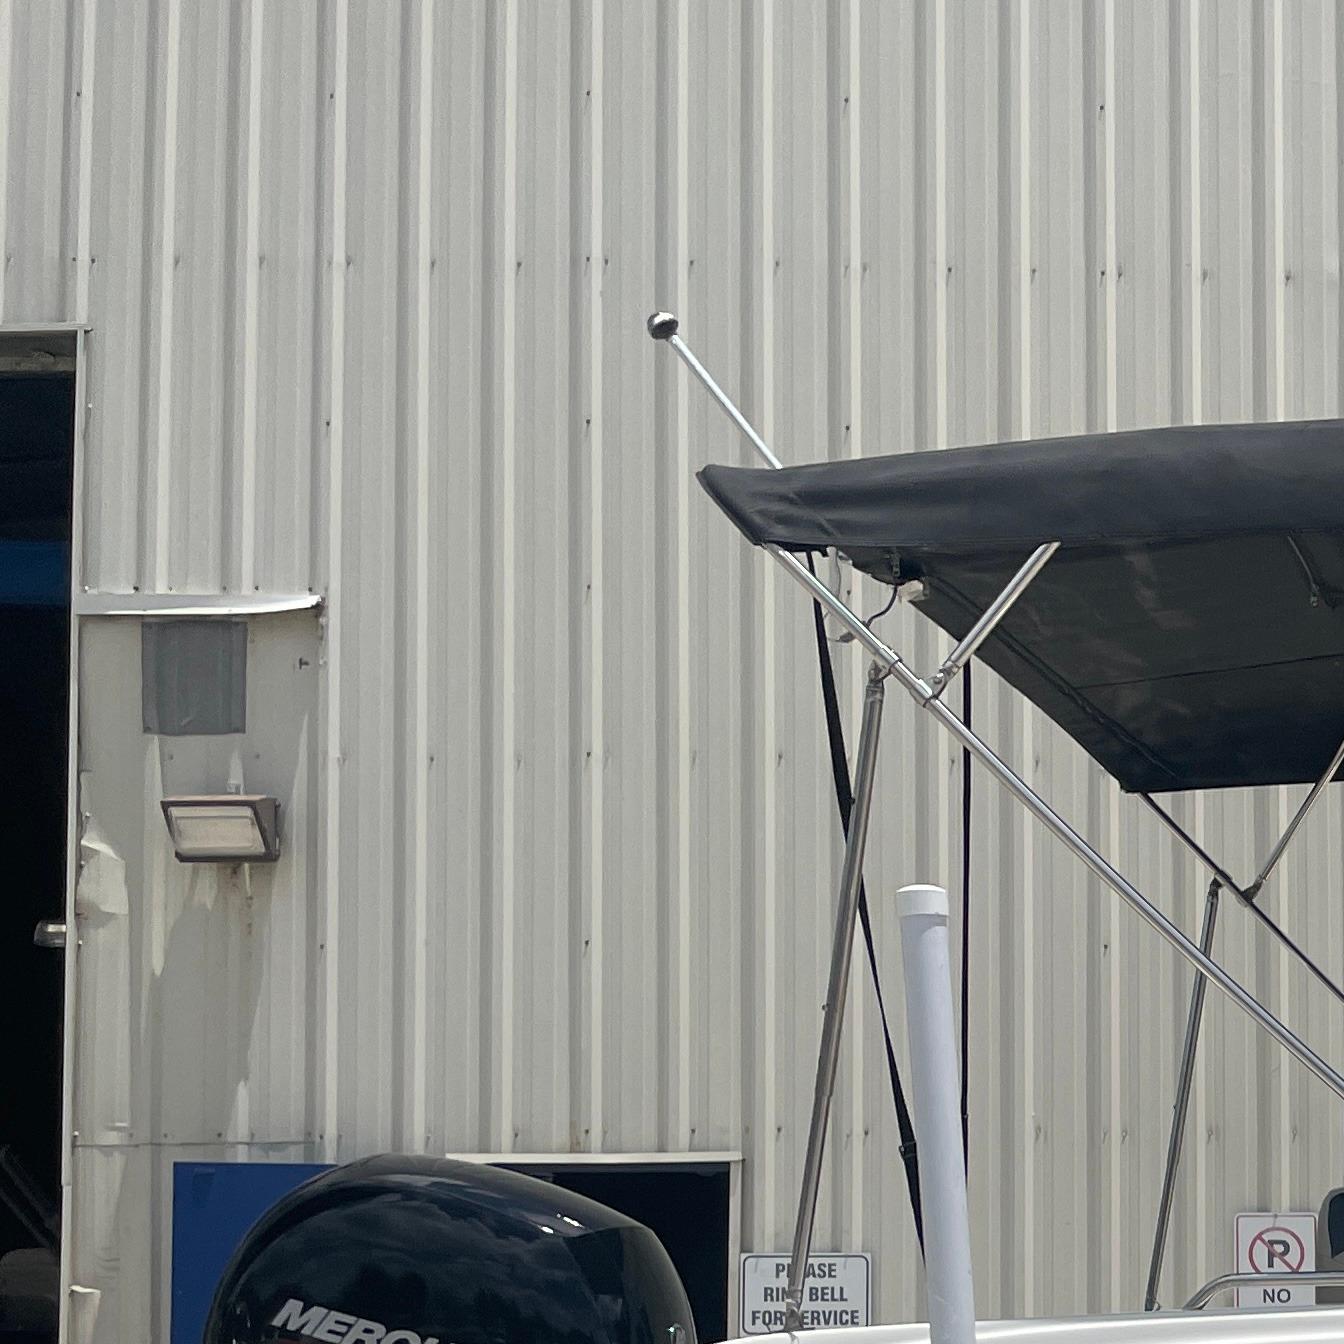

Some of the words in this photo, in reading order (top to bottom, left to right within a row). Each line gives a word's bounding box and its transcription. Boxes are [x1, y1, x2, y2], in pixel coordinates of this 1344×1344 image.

[808, 1286, 849, 1302] BELL
[1262, 1288, 1291, 1304] NO
[751, 1310, 786, 1326] FOR
[800, 1309, 860, 1326] ERVICE
